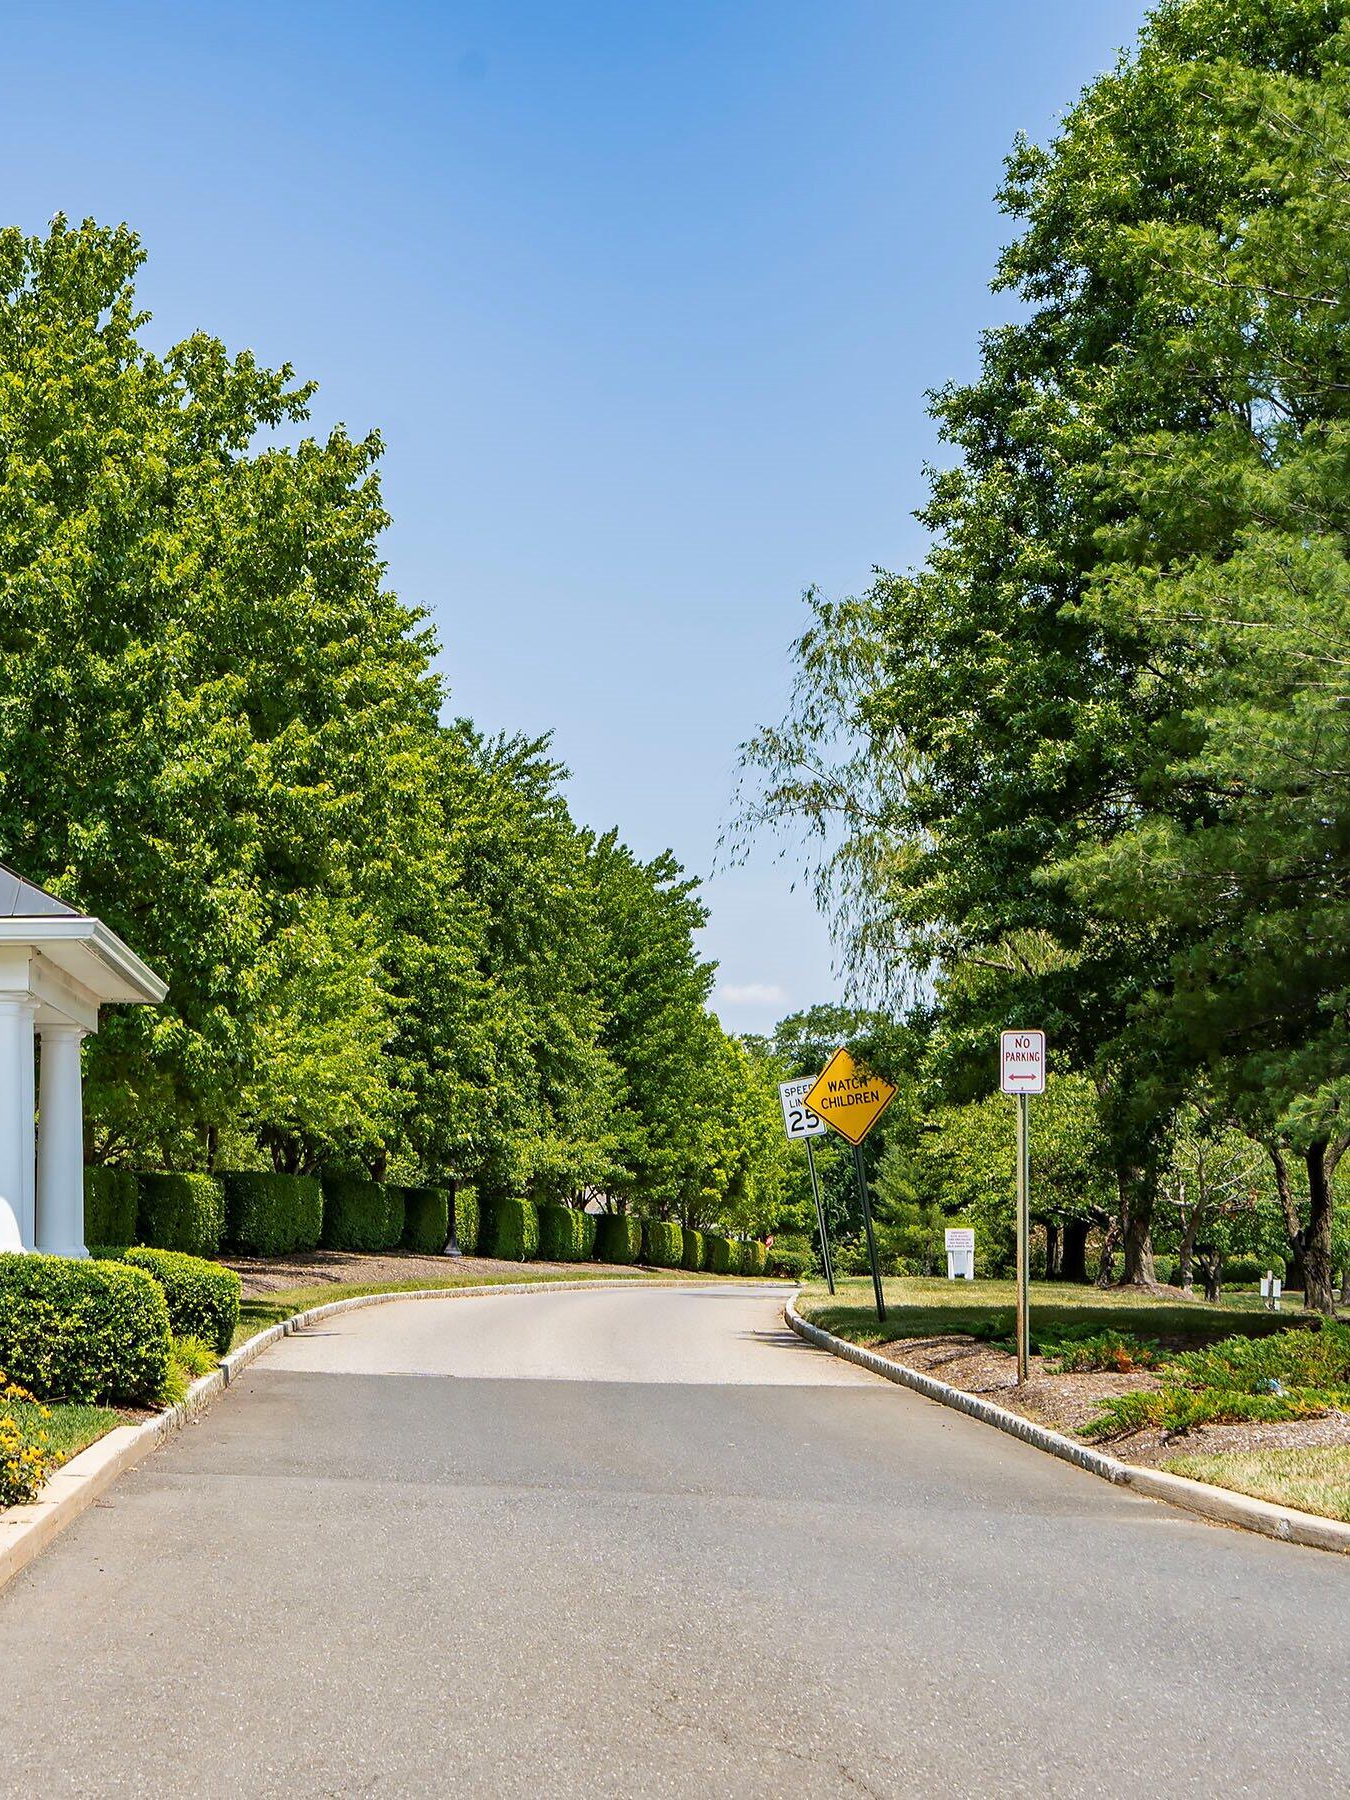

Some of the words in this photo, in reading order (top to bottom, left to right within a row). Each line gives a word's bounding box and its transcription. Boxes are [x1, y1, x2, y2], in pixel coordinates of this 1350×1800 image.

[1015, 1038, 1030, 1048] NO
[1006, 1052, 1040, 1062] PARKING
[828, 1076, 868, 1092] WATCH
[821, 1091, 879, 1109] CHILDREN
[789, 1109, 819, 1132] 25
